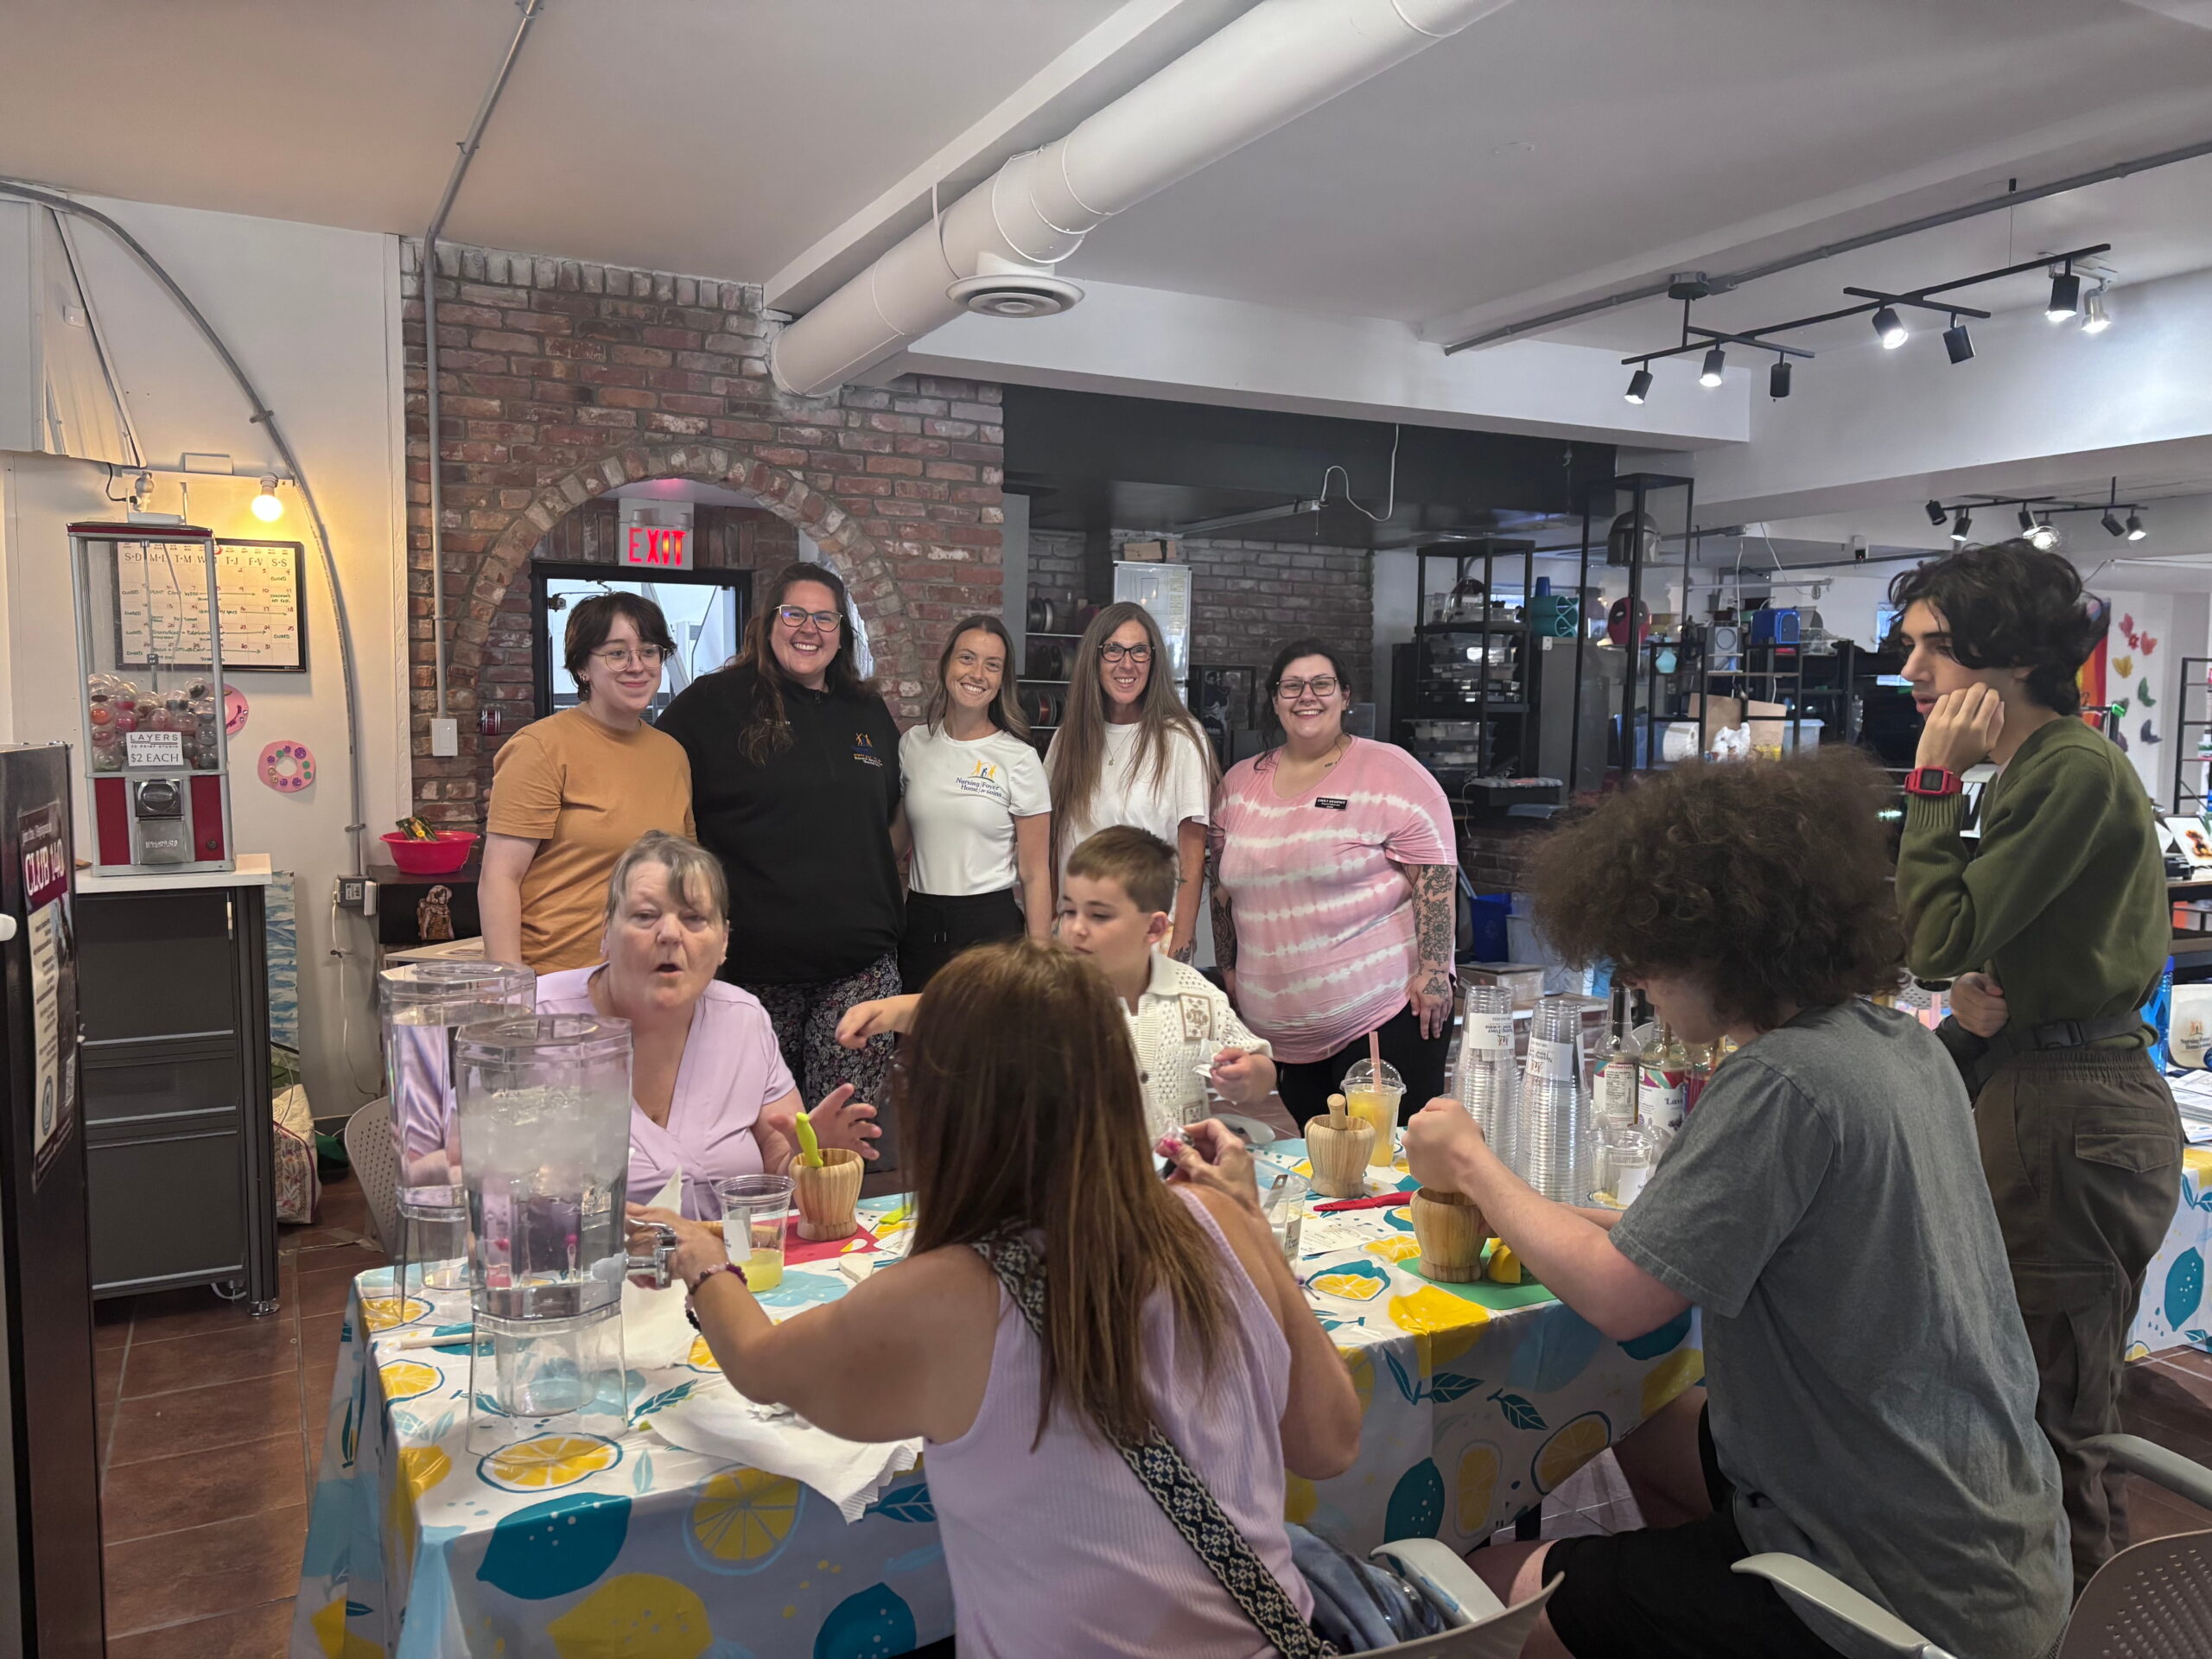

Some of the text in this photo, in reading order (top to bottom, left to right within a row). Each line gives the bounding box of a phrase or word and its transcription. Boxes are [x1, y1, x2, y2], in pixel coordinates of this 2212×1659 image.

[628, 527, 686, 566] EXIT
[131, 753, 179, 763] $2 EACH
[956, 778, 999, 791] Nursing Foyer
[24, 846, 50, 896] CLUB
